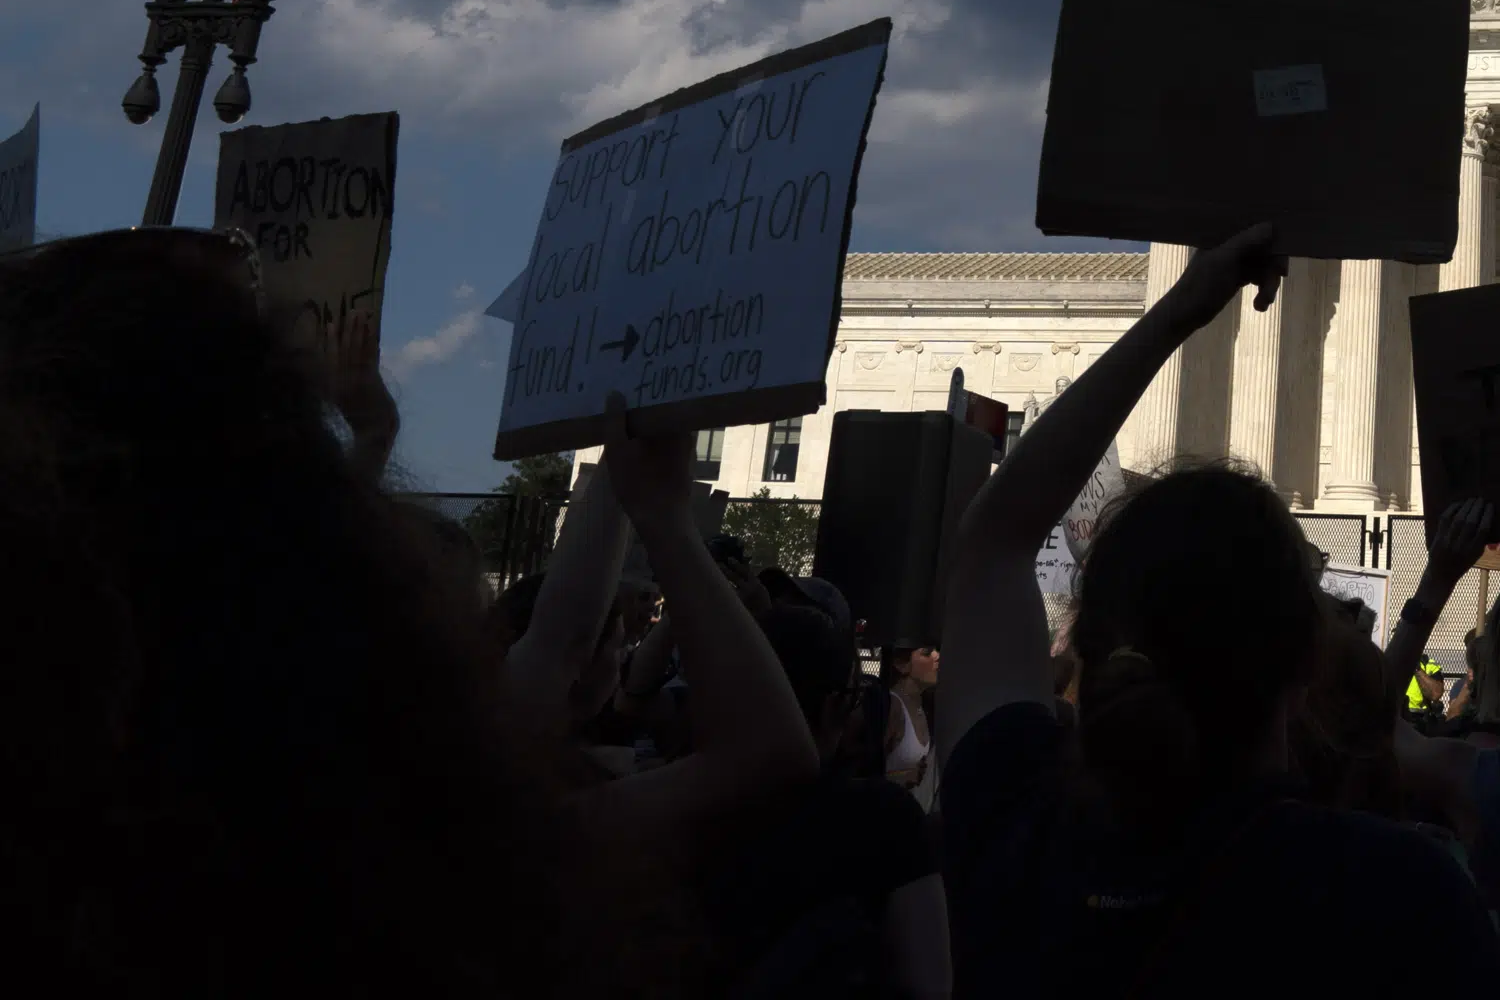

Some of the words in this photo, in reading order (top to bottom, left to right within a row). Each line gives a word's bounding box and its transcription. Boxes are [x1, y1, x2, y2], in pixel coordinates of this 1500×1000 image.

[230, 155, 392, 220] ABORTION
[257, 221, 313, 263] FOR
[520, 202, 612, 320] local
[627, 156, 830, 276] abortion
[509, 304, 598, 406] fund!
[642, 287, 763, 359] abortion
